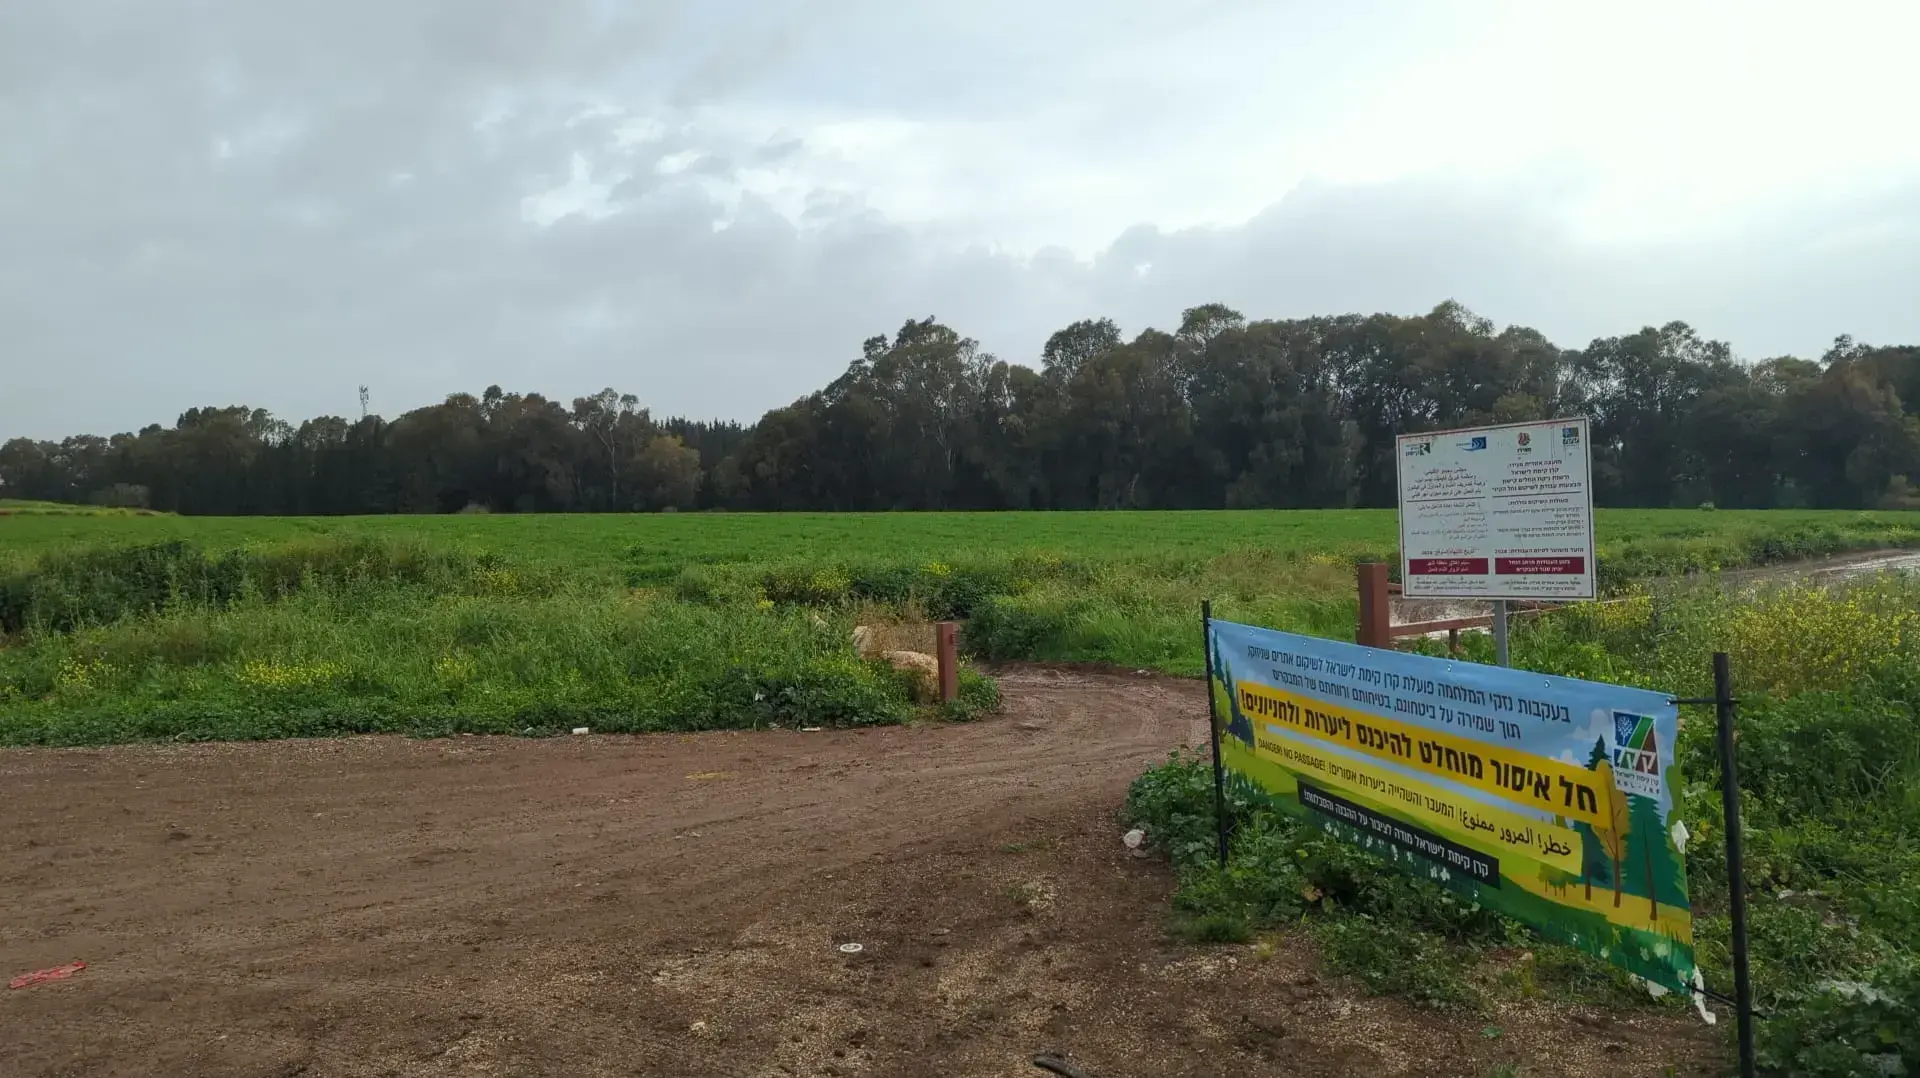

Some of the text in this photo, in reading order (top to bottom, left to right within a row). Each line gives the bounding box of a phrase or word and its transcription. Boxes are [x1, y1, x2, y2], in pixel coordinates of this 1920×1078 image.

[1549, 467, 1559, 475] קרן
[1272, 651, 1294, 665] אתרים
[1296, 654, 1323, 672] לשיקום
[1326, 660, 1355, 678] לישראל
[1359, 668, 1381, 686] קימת
[1384, 673, 1400, 691] קרן
[1402, 676, 1434, 694] פועלת
[1438, 682, 1486, 705] המלחמה
[1489, 692, 1513, 712] נזקי
[1272, 669, 1521, 740] תוך שמירה על ביטחונם, בטיחותם ורווחתם של המבקרים
[1518, 698, 1570, 723] בעקבות
[1240, 689, 1598, 814] חל איסור מוחלט להיכנס ליערות ולחניונים!
[1258, 738, 1326, 771] DANGER! NO PASSAGE!
[1329, 761, 1454, 818] המעבר והשהייה ביערות אסורים!
[1335, 802, 1357, 821] ההבנה
[1358, 811, 1368, 826] על
[1370, 817, 1392, 835] לציבור
[1459, 808, 1571, 856] خطر! المرور ممنوع!
[1394, 827, 1413, 845] מודה
[1414, 835, 1445, 858] לישראל
[1448, 849, 1470, 870] קימת
[1473, 859, 1488, 877] קרן
